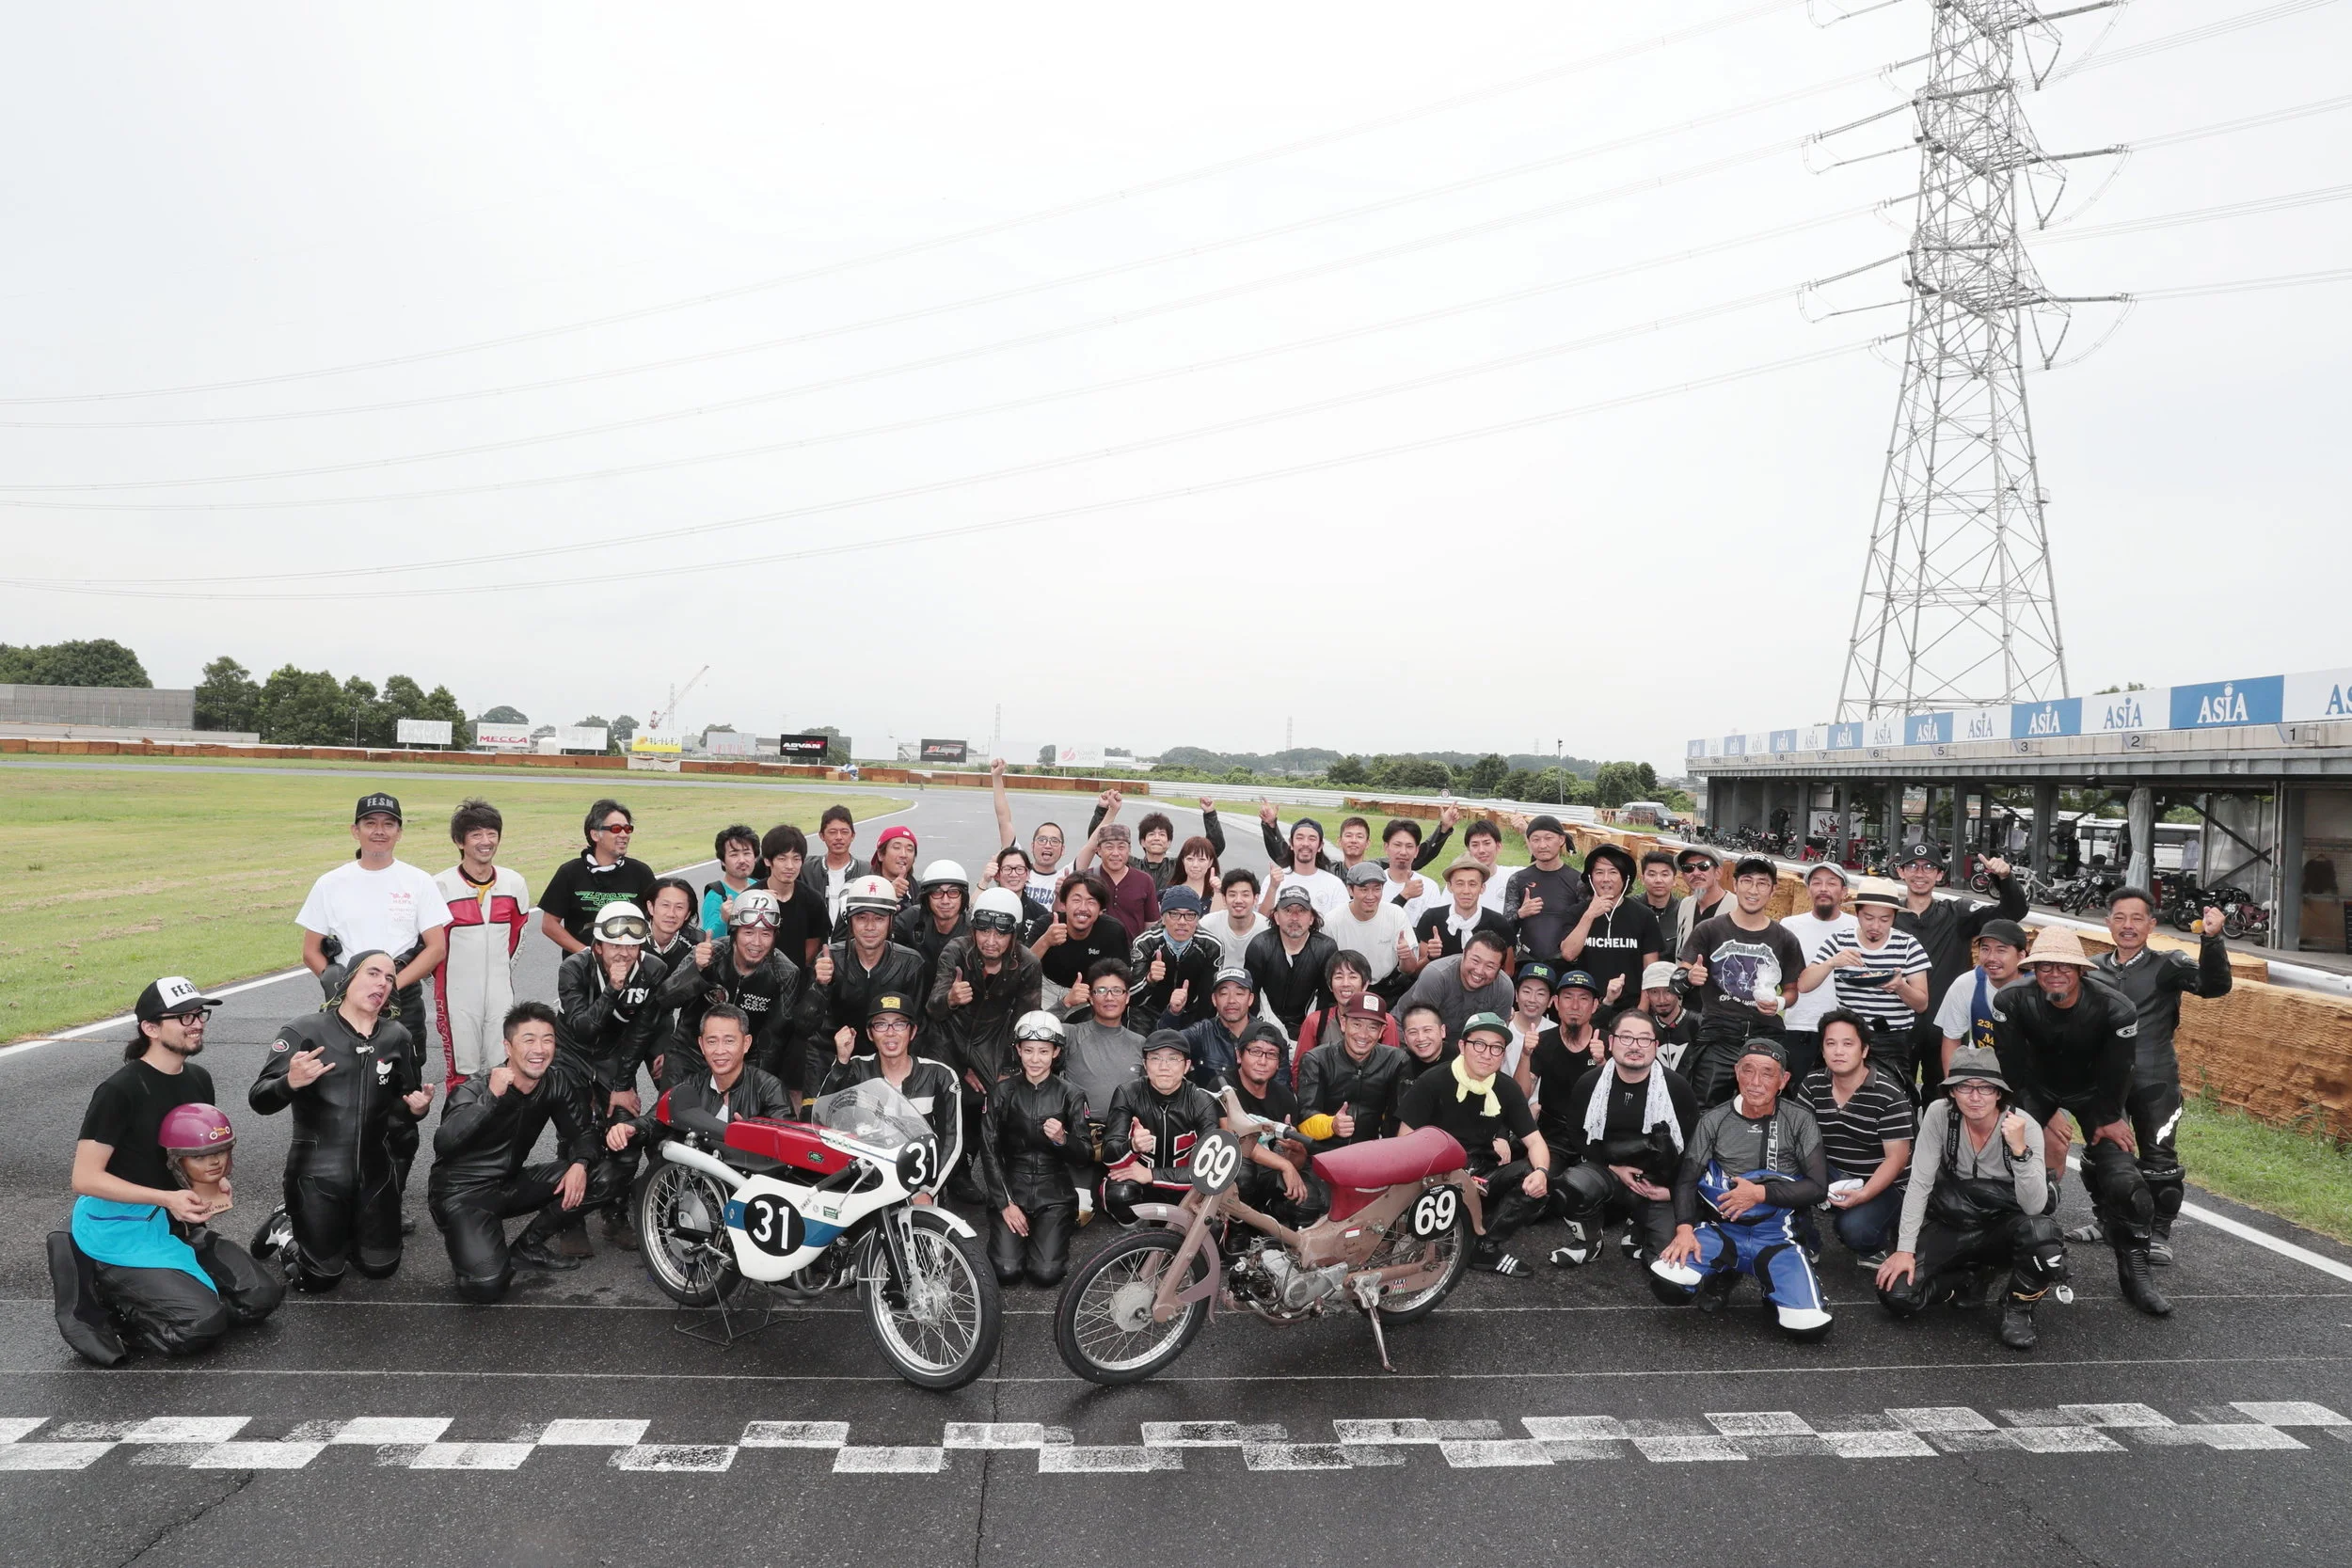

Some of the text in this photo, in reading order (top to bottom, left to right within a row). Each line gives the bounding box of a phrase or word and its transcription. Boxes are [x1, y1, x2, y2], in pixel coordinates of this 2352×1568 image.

[2196, 682, 2249, 724] ASIA
[2325, 684, 2352, 716] AS
[2027, 703, 2061, 735] ASIA
[2103, 697, 2143, 730] ASIA
[1873, 723, 1892, 745] ASIA
[1915, 716, 1939, 742] ASIA
[1967, 712, 1994, 739] ASIA
[2289, 728, 2296, 740] 1
[479, 736, 528, 744] MECCA
[1775, 731, 1789, 752] ASIA
[1804, 730, 1819, 750] ASIA
[1836, 726, 1853, 748] ASIA
[2021, 742, 2028, 752] 3
[2131, 736, 2140, 748] 2
[1872, 749, 1880, 758] 6
[1937, 746, 1945, 755] 5
[2091, 876, 2102, 885] 63
[752, 896, 770, 910] 72
[2184, 901, 2196, 910] 72
[1584, 937, 1638, 949] MICHELIN
[744, 998, 767, 1008] CSC
[1766, 1120, 1778, 1172] AICHI
[905, 1138, 938, 1185] 31
[1193, 1134, 1237, 1189] 69
[1414, 1190, 1456, 1236] 69
[753, 1199, 790, 1250] 31
